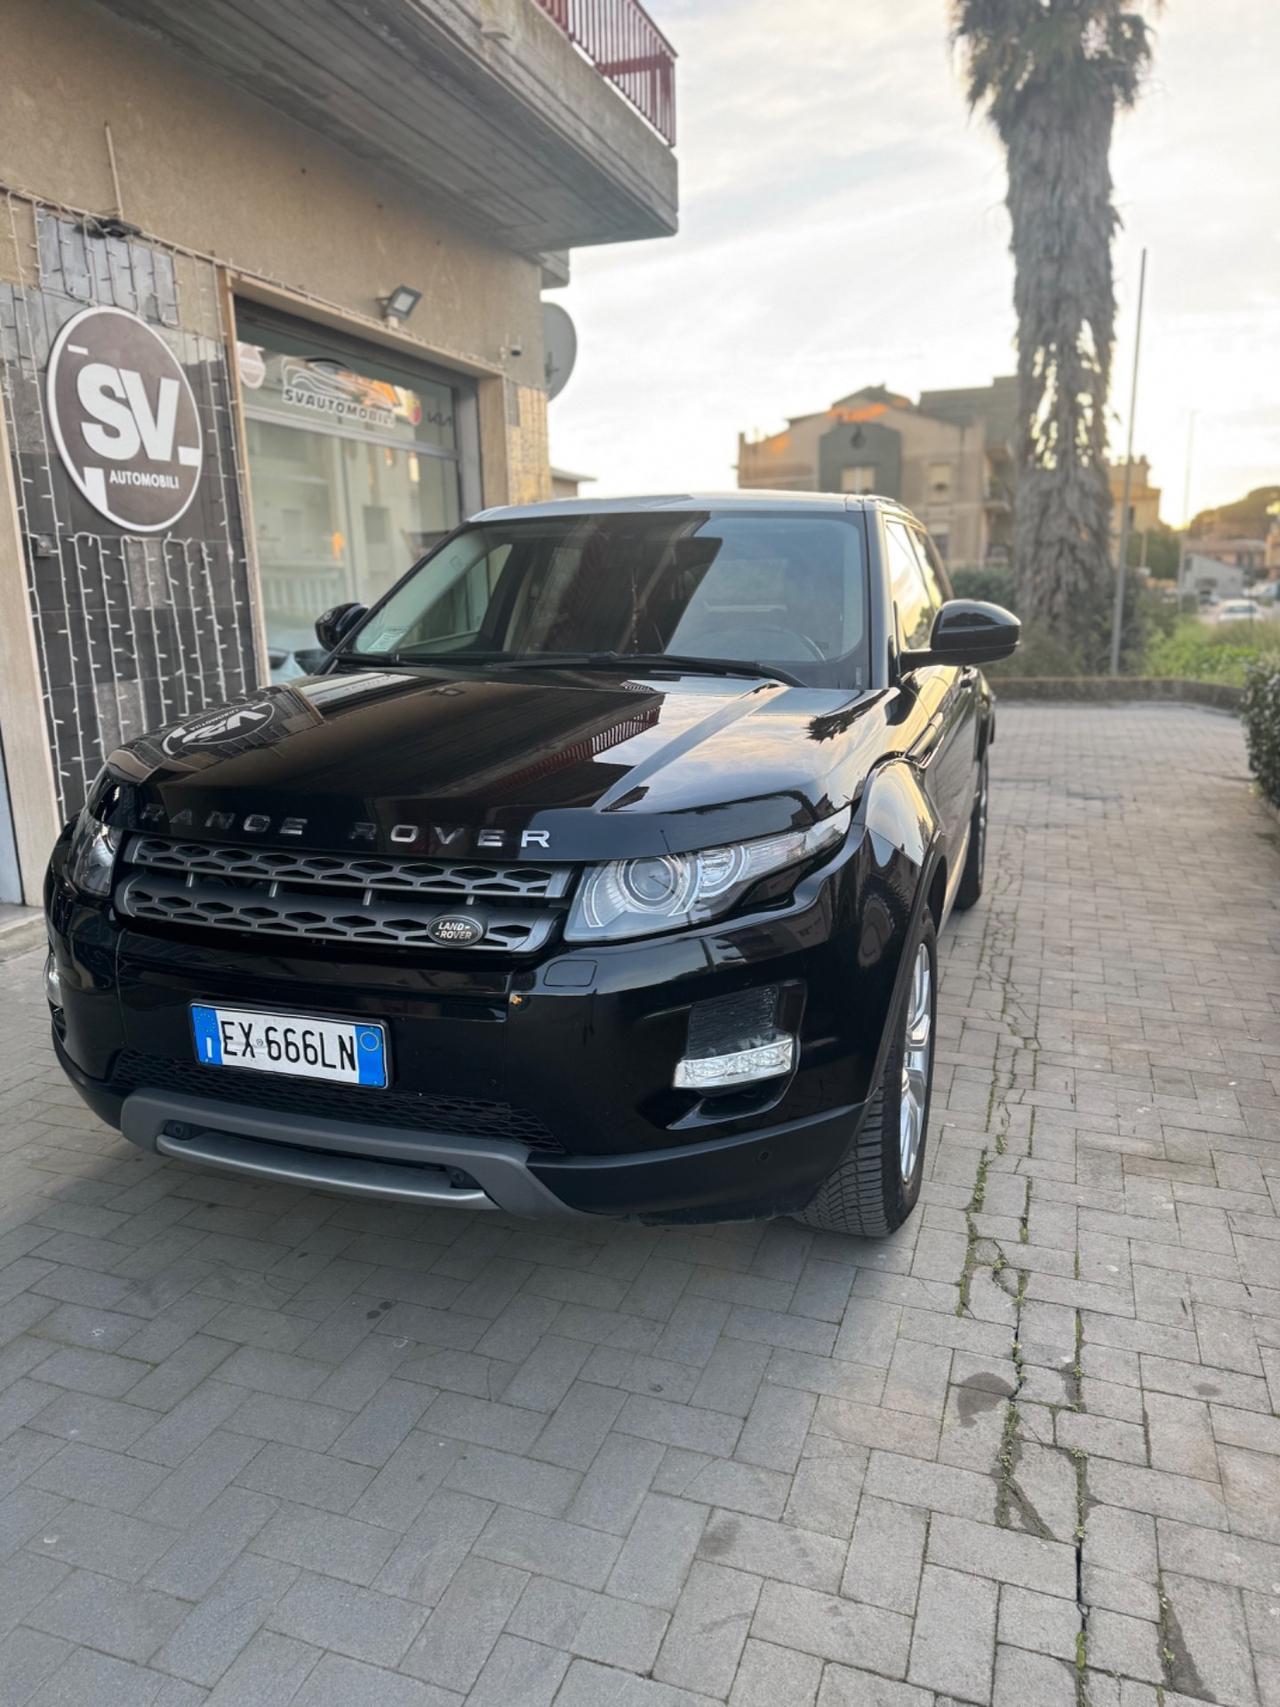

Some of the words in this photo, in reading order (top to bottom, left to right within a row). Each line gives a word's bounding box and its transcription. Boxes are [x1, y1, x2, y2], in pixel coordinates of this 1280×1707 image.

[109, 469, 180, 489] AUTOMOBILI
[139, 802, 308, 836] RANGE
[350, 822, 550, 848] ROVER
